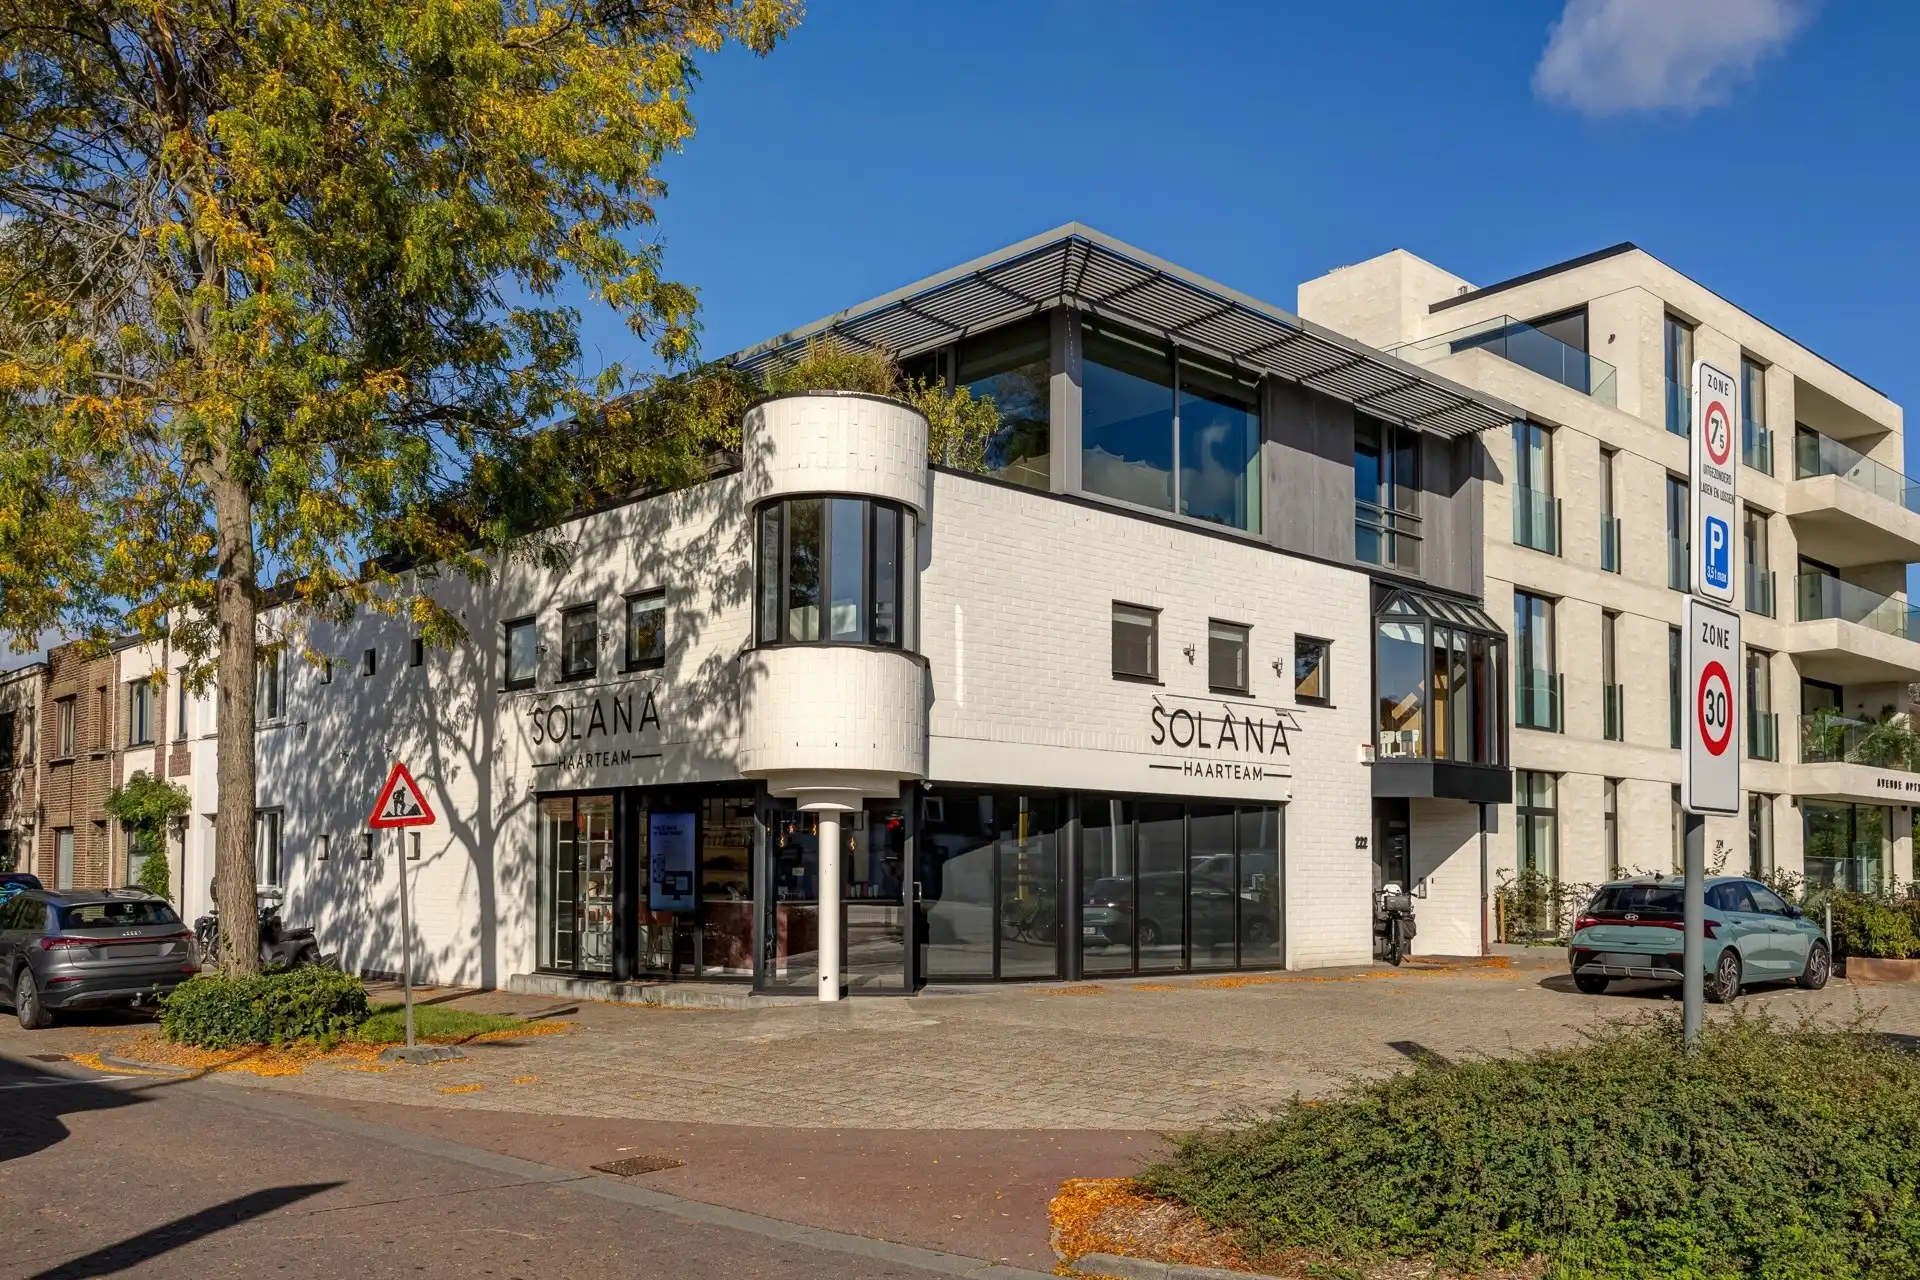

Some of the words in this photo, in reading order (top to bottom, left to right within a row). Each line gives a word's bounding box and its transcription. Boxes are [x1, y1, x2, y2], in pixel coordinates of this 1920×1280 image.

[1707, 373, 1729, 396] ZONE
[1703, 463, 1732, 485] UITGEZONDERD
[1700, 482, 1713, 496] LADEN
[1713, 486, 1720, 499] EN
[1720, 490, 1735, 505] LOSSEN
[1710, 522, 1724, 567] P
[1702, 621, 1730, 650] ZONE
[532, 691, 661, 746] SOLANA
[1705, 688, 1727, 728] 30
[1151, 705, 1291, 756] SOLANA
[558, 749, 631, 771] HAARTEAM
[1184, 760, 1263, 781] HAARTEAM
[1876, 778, 1902, 791] AVENUE
[1355, 836, 1368, 849] 222
